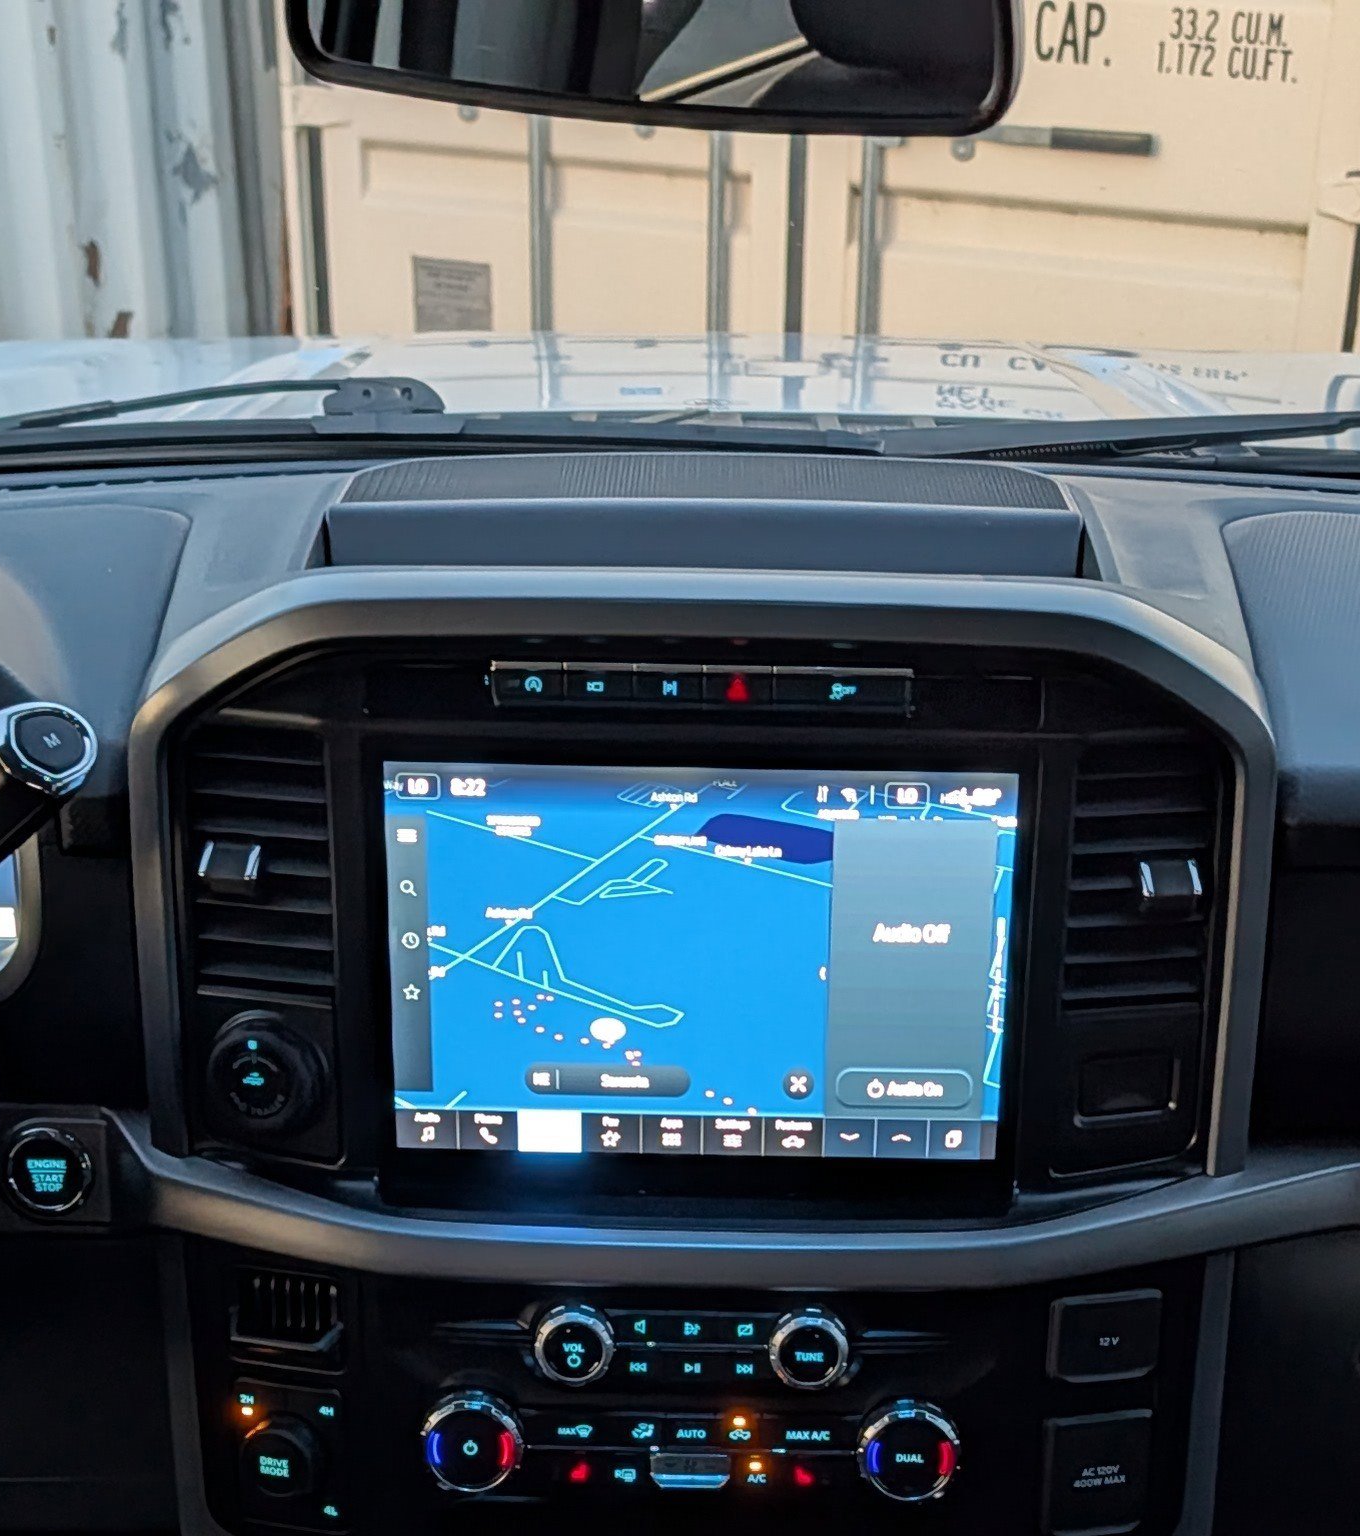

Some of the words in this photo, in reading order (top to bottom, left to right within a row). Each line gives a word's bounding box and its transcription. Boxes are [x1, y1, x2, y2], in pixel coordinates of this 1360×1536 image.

[1169, 7, 1219, 42] 33.2
[1231, 11, 1288, 47] CU.M.
[1035, 0, 1111, 68] CAP.
[1157, 41, 1216, 77] 1.172
[1227, 46, 1298, 84] CU.FT.
[872, 923, 921, 944] Audio
[922, 924, 951, 944] Off
[26, 1159, 67, 1170] ENGINE
[31, 1174, 64, 1183] START
[34, 1183, 63, 1192] STOP
[562, 1342, 585, 1353] VOL
[794, 1351, 824, 1363] TUNE
[557, 1426, 576, 1436] MAX
[676, 1428, 706, 1439] AUTO
[785, 1430, 810, 1441] MAX
[811, 1430, 831, 1441] A/C
[259, 1455, 289, 1469] DRIVE
[895, 1453, 924, 1464] DUAL
[259, 1466, 290, 1478] MODE
[747, 1473, 767, 1484] A/C
